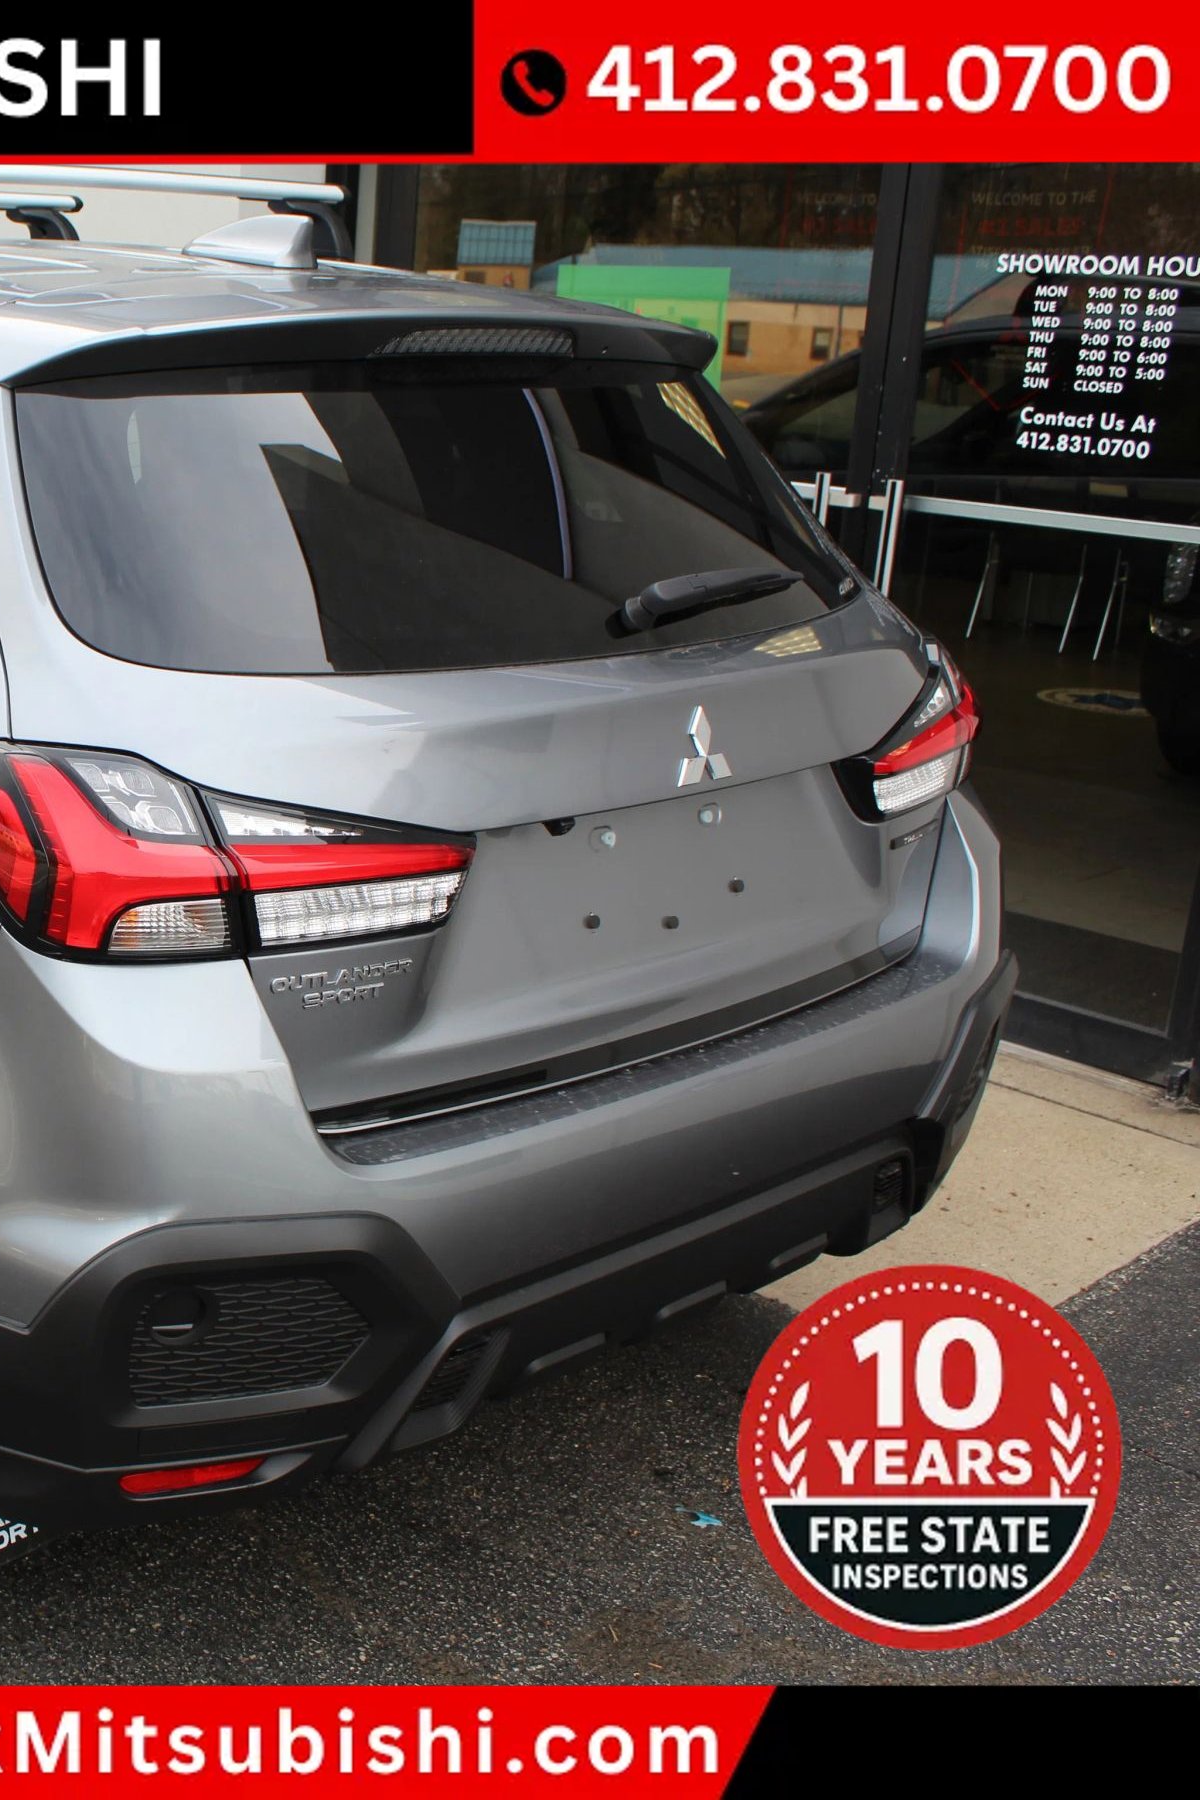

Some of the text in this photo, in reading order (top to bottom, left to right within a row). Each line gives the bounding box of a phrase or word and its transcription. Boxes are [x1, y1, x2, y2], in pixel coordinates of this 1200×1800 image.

[996, 254, 1139, 276] SHOWROOM
[1035, 286, 1179, 301] MON 9:00 TO 8:00
[1034, 301, 1176, 316] TUE 9:00 TO 8:00
[1032, 316, 1173, 332] WED 9:00 TO 8:00
[1029, 332, 1170, 348] THU 9:00 TO 8:00
[1027, 346, 1167, 364] FRI 9:00 TO 6:00
[1024, 362, 1165, 380] SAT 9:00 TO 5:00
[1022, 377, 1124, 394] SUN CLOSED
[1019, 407, 1156, 434] Contact Us At
[1016, 431, 1151, 459] 412.831.0700
[270, 957, 414, 994] OUTLANDER
[302, 982, 385, 1010] SPORT
